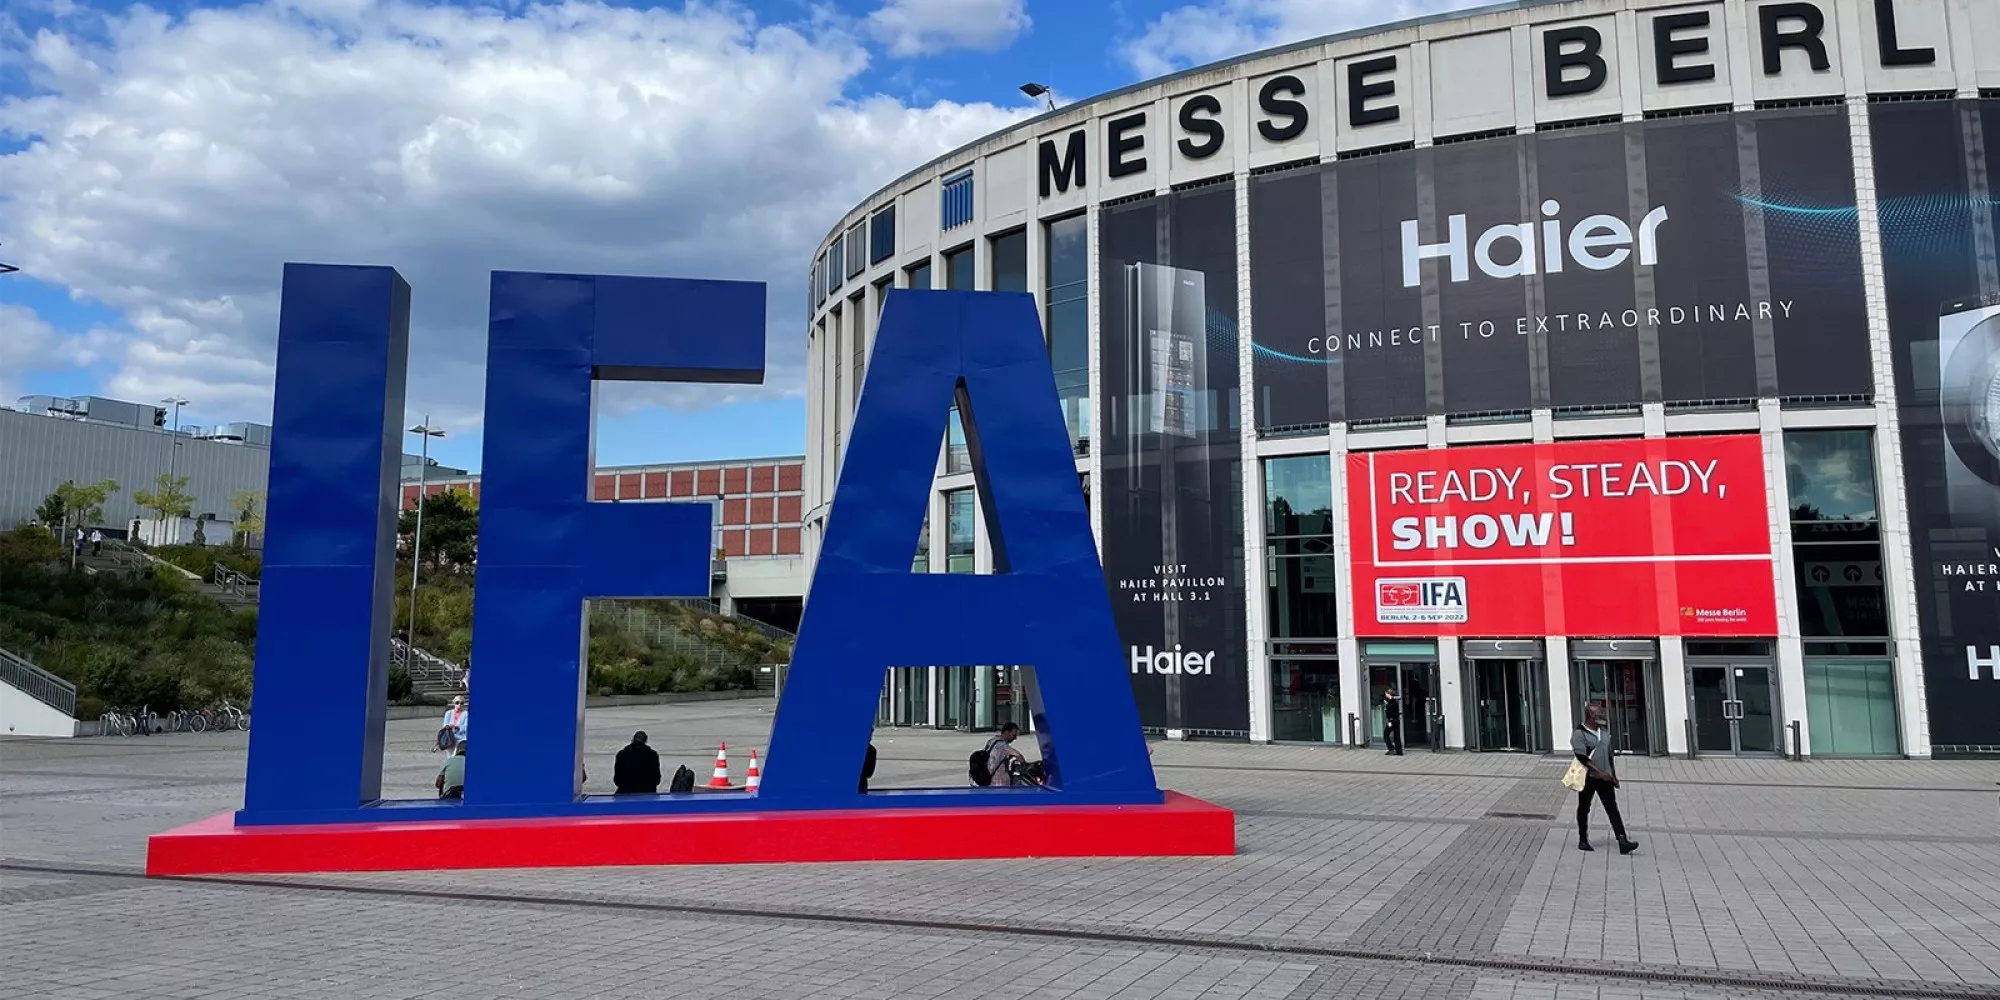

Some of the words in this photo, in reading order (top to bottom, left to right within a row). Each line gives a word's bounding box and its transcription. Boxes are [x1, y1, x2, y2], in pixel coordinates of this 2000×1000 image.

[1038, 55, 1400, 198] MESSE
[1401, 199, 1669, 288] Haier
[1307, 324, 1441, 355] CONNECT
[1459, 320, 1496, 339] TO
[1516, 299, 1795, 335] EXTRAORDINARY
[1389, 466, 1531, 505] READY,
[1549, 459, 1727, 500] STEADY,
[240, 262, 1162, 818] IFA
[1391, 511, 1575, 551] SHOW!
[1120, 579, 1156, 589] HAIER
[1162, 577, 1225, 588] PAVILLON
[1153, 564, 1187, 574] VISIT
[1942, 564, 1998, 575] HAIER
[1133, 592, 1147, 602] AT
[1153, 591, 1183, 602] HALL
[1190, 591, 1211, 601] 3.1
[1422, 582, 1463, 606] IFA
[1965, 580, 1985, 591] AT
[1723, 608, 1747, 616] Berlin
[1131, 643, 1216, 675] Haier
